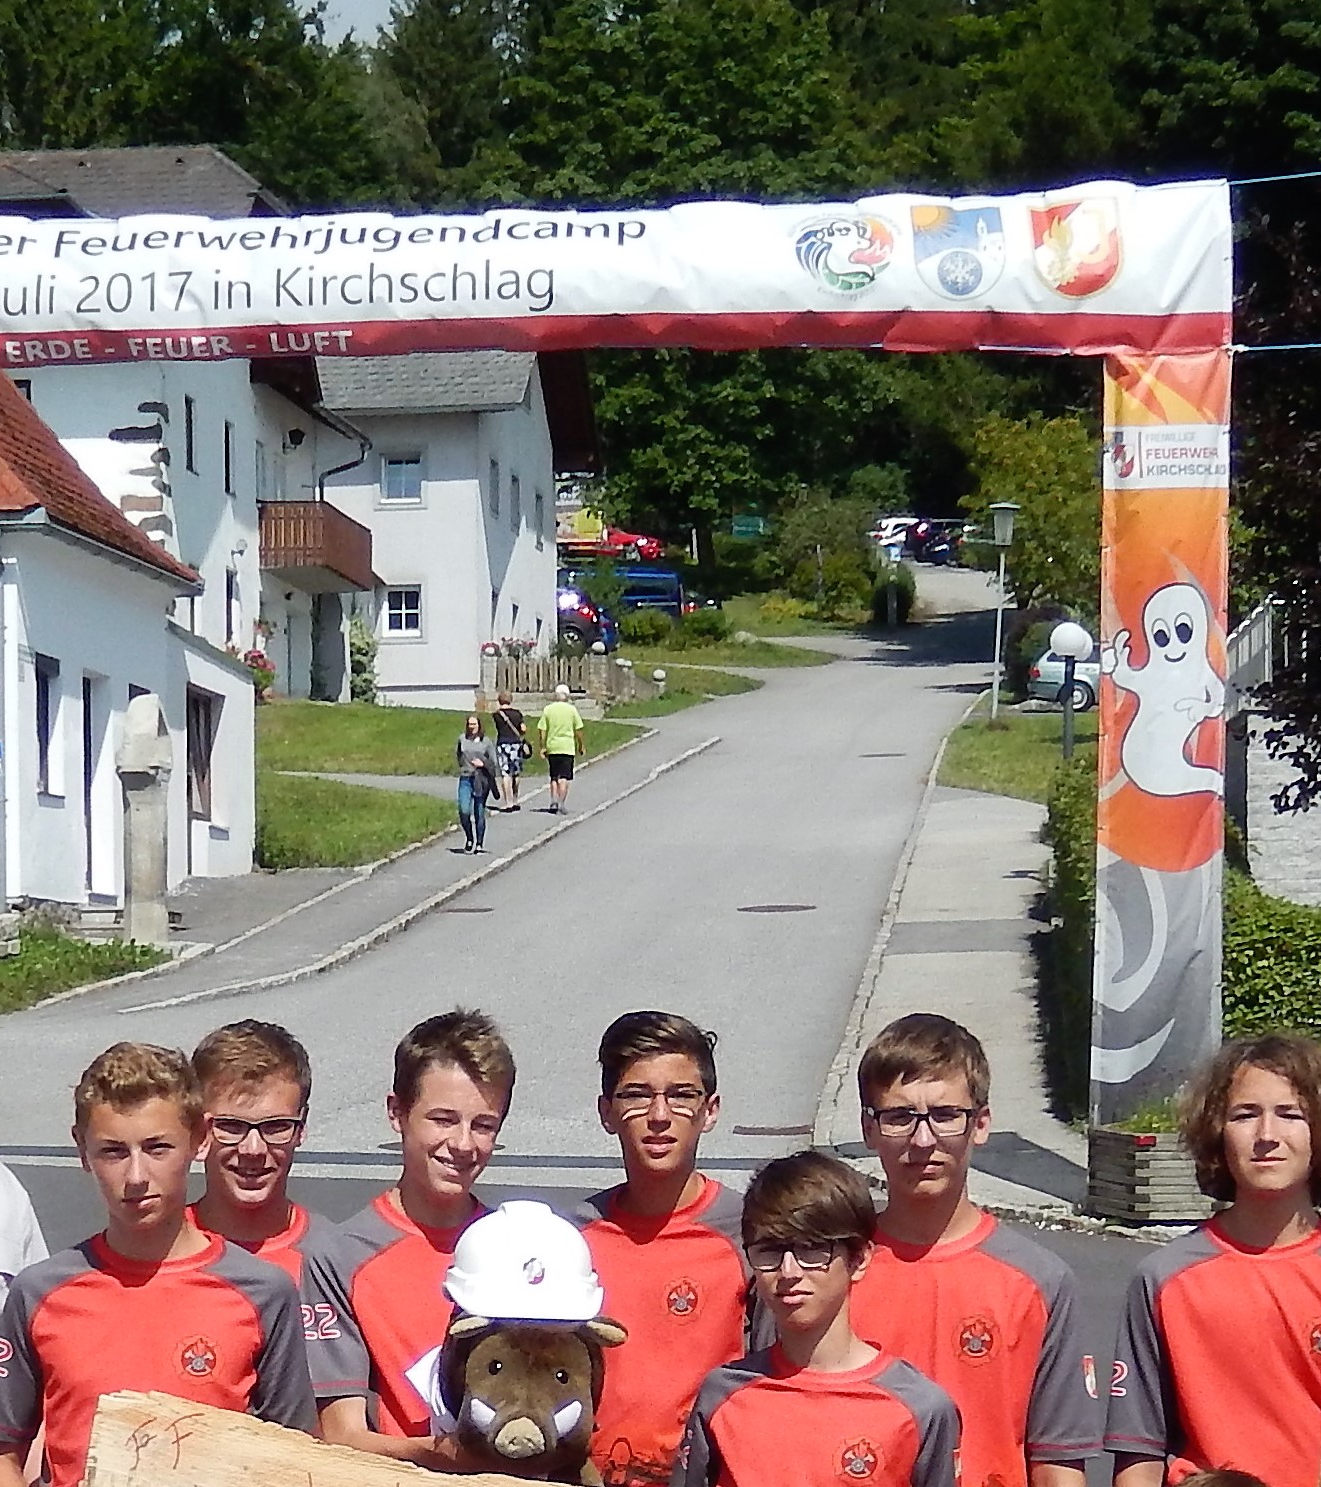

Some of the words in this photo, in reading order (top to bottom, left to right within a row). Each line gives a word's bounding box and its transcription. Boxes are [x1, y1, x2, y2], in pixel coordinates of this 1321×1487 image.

[54, 217, 646, 257] Feuerwehrjugendcamp
[76, 271, 193, 314] 2017
[214, 269, 252, 311] in
[276, 261, 554, 311] Kirchschlag
[5, 338, 91, 364] ERDE
[129, 335, 233, 359] FEUER
[269, 330, 355, 354] LUFT
